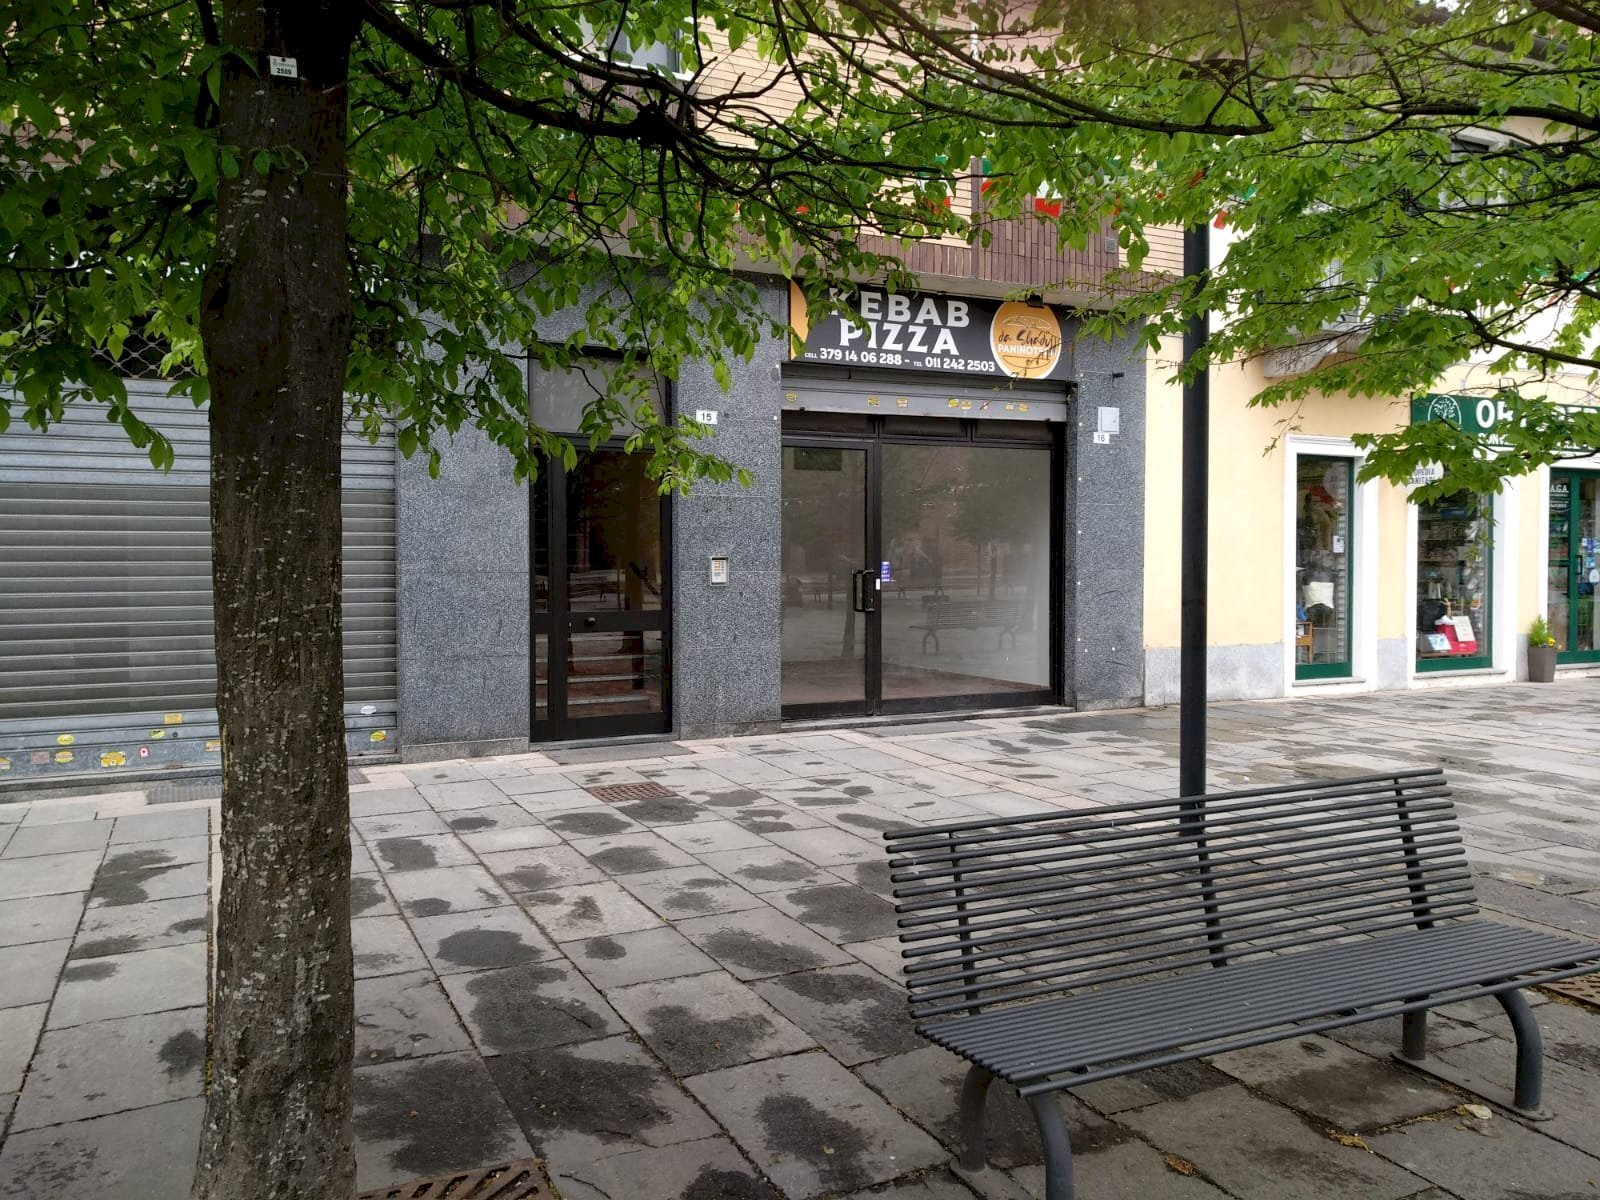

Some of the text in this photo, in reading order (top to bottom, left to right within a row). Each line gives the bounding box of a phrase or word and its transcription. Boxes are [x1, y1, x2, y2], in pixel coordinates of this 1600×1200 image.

[839, 318, 960, 355] PIZZA
[820, 347, 842, 360] 379
[845, 350, 858, 362] 14
[860, 351, 877, 363] 06
[879, 353, 902, 365] 288
[925, 356, 941, 368] 011
[943, 358, 965, 370] 242
[967, 360, 996, 372] 2503
[702, 413, 712, 422] 15
[1097, 434, 1106, 442] 16
